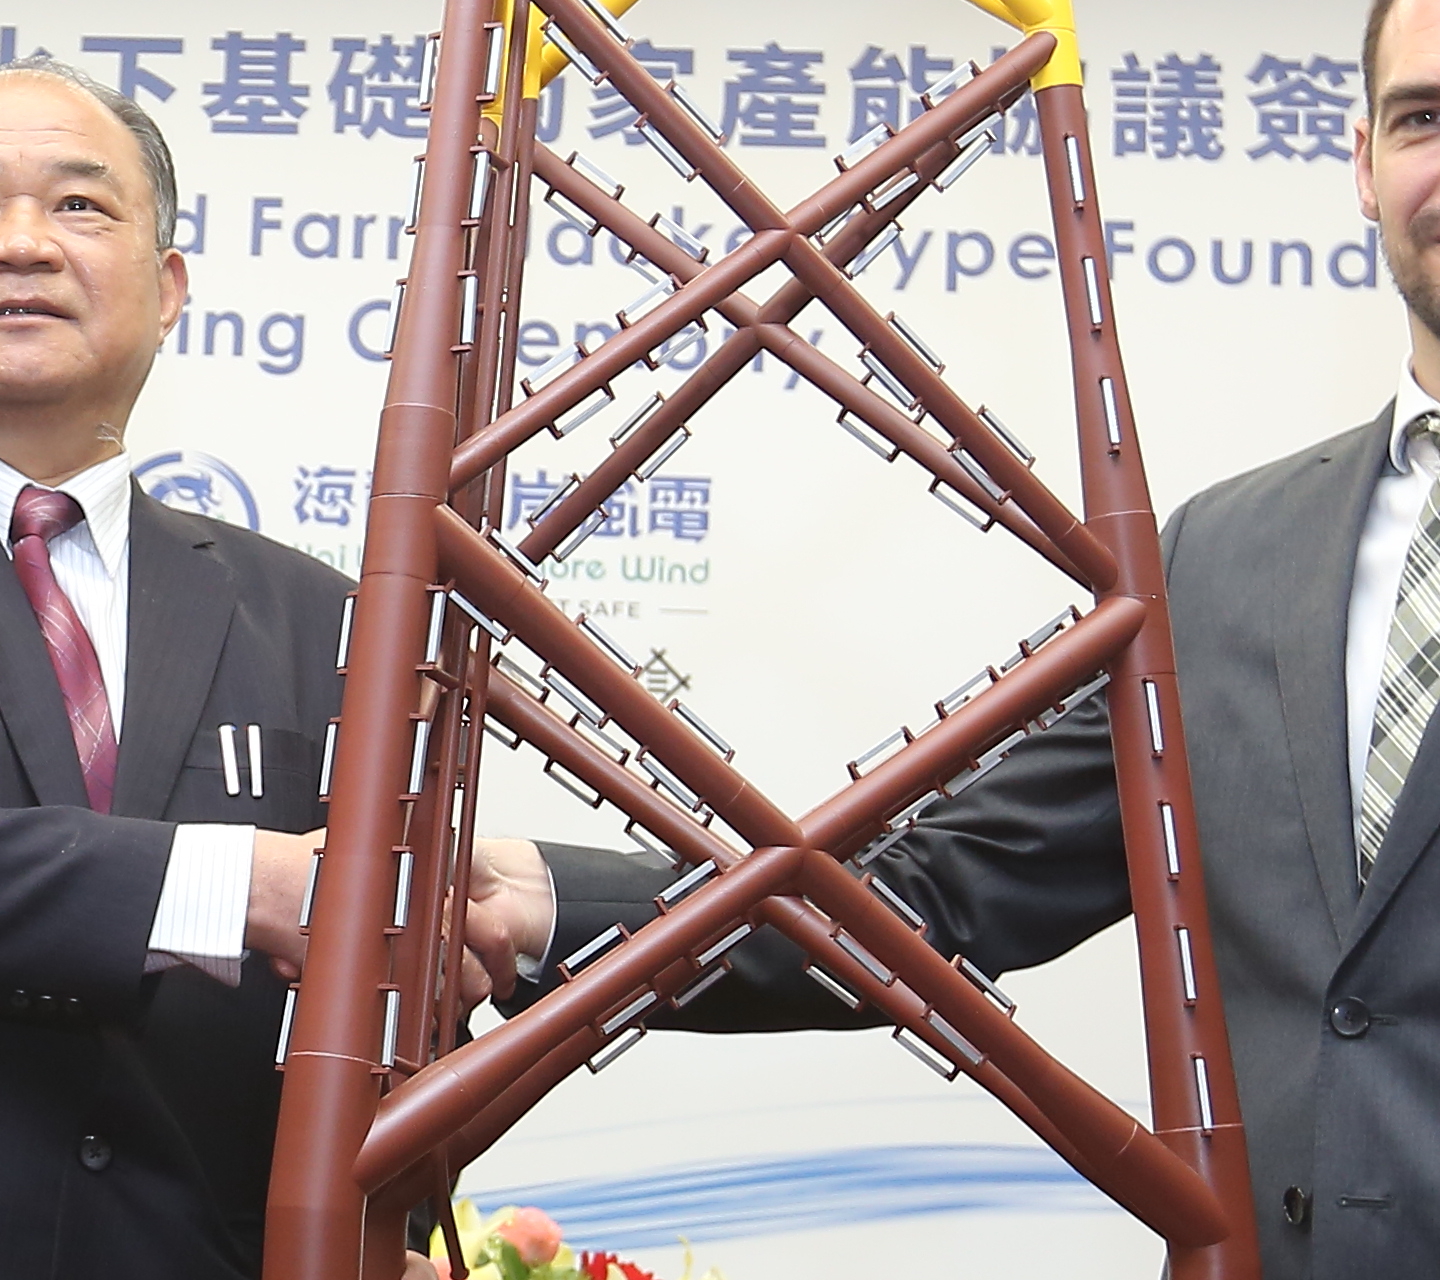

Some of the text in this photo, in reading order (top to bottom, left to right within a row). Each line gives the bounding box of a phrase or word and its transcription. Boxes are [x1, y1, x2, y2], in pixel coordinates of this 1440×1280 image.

[847, 214, 1055, 292] ype
[1105, 221, 1377, 288] Found
[621, 556, 711, 584] Wind
[579, 599, 640, 618] SAFE
